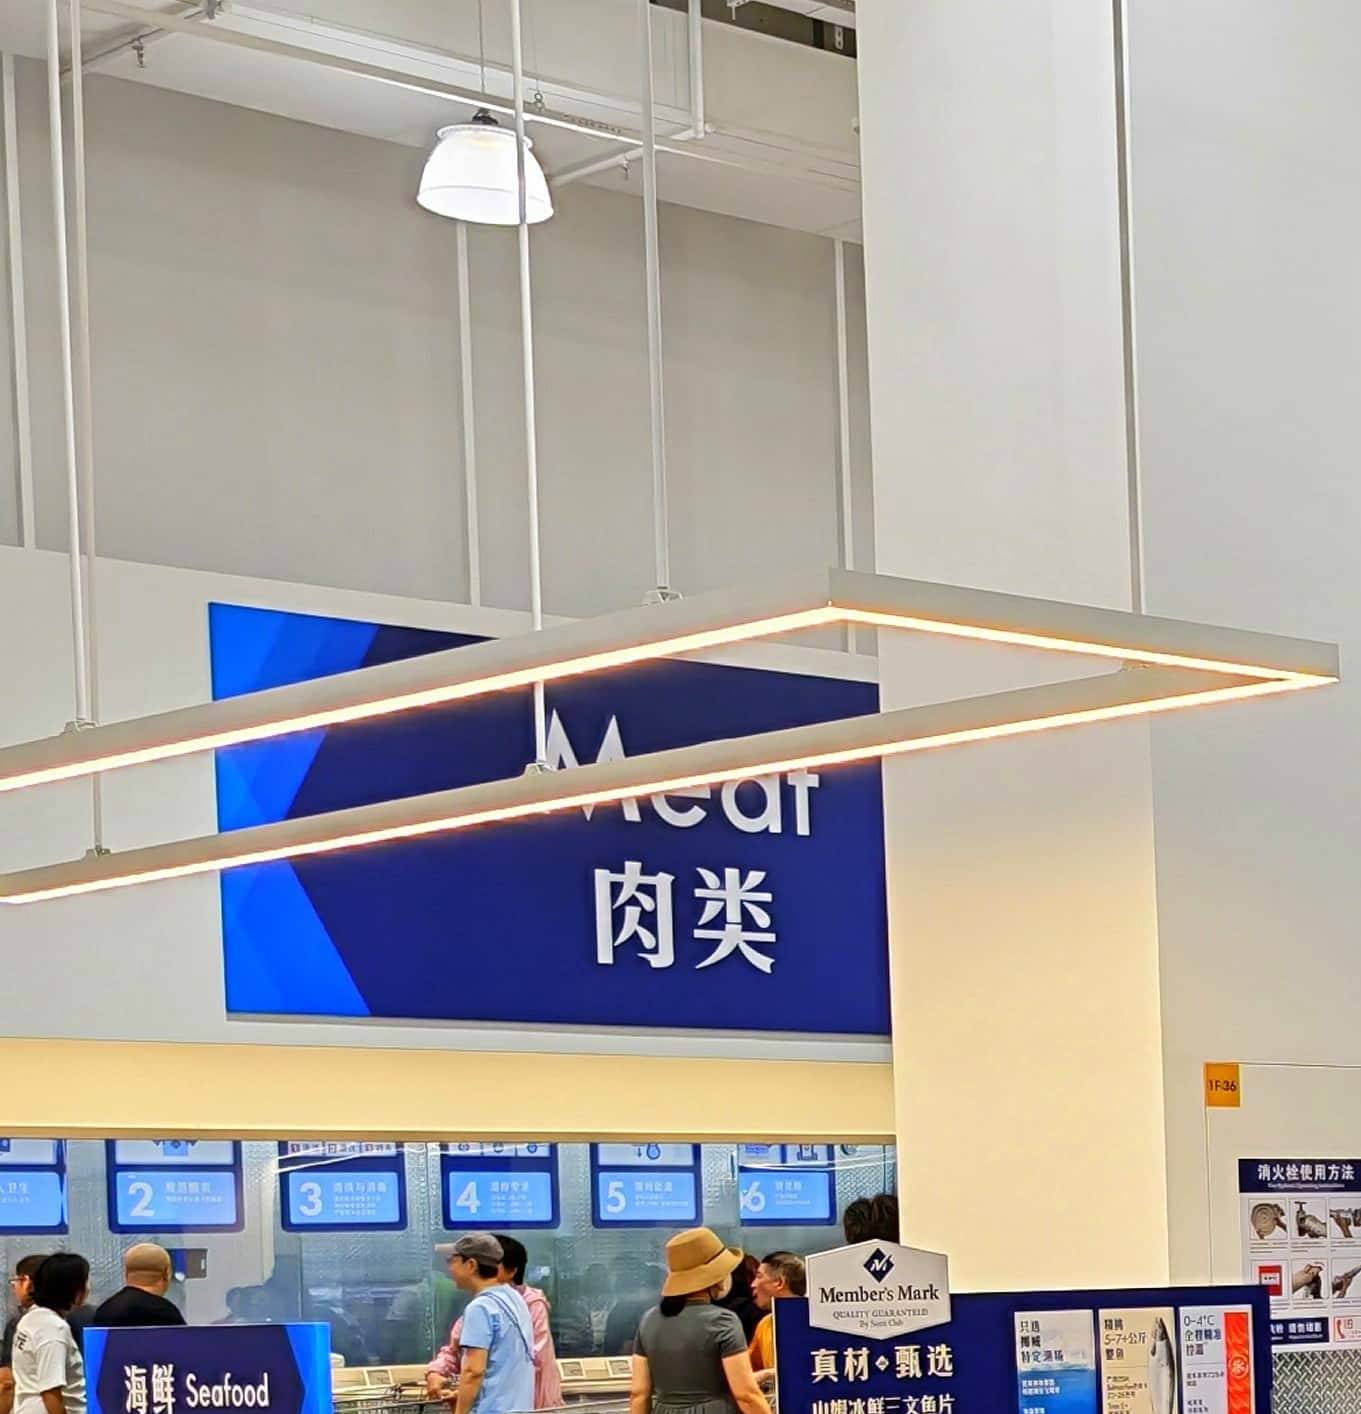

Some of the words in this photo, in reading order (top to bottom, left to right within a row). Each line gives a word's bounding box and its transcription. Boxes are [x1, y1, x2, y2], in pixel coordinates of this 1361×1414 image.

[594, 859, 777, 974] 肉类
[1257, 1163, 1356, 1181] 消火栓使用方法
[128, 1181, 155, 1217] 2
[300, 1181, 322, 1217] 3
[456, 1181, 480, 1214] 4
[607, 1181, 627, 1214] 5
[748, 1181, 766, 1213] 6
[819, 1286, 894, 1304] Member's
[898, 1284, 940, 1301] Mark
[185, 1372, 271, 1408] Seafood
